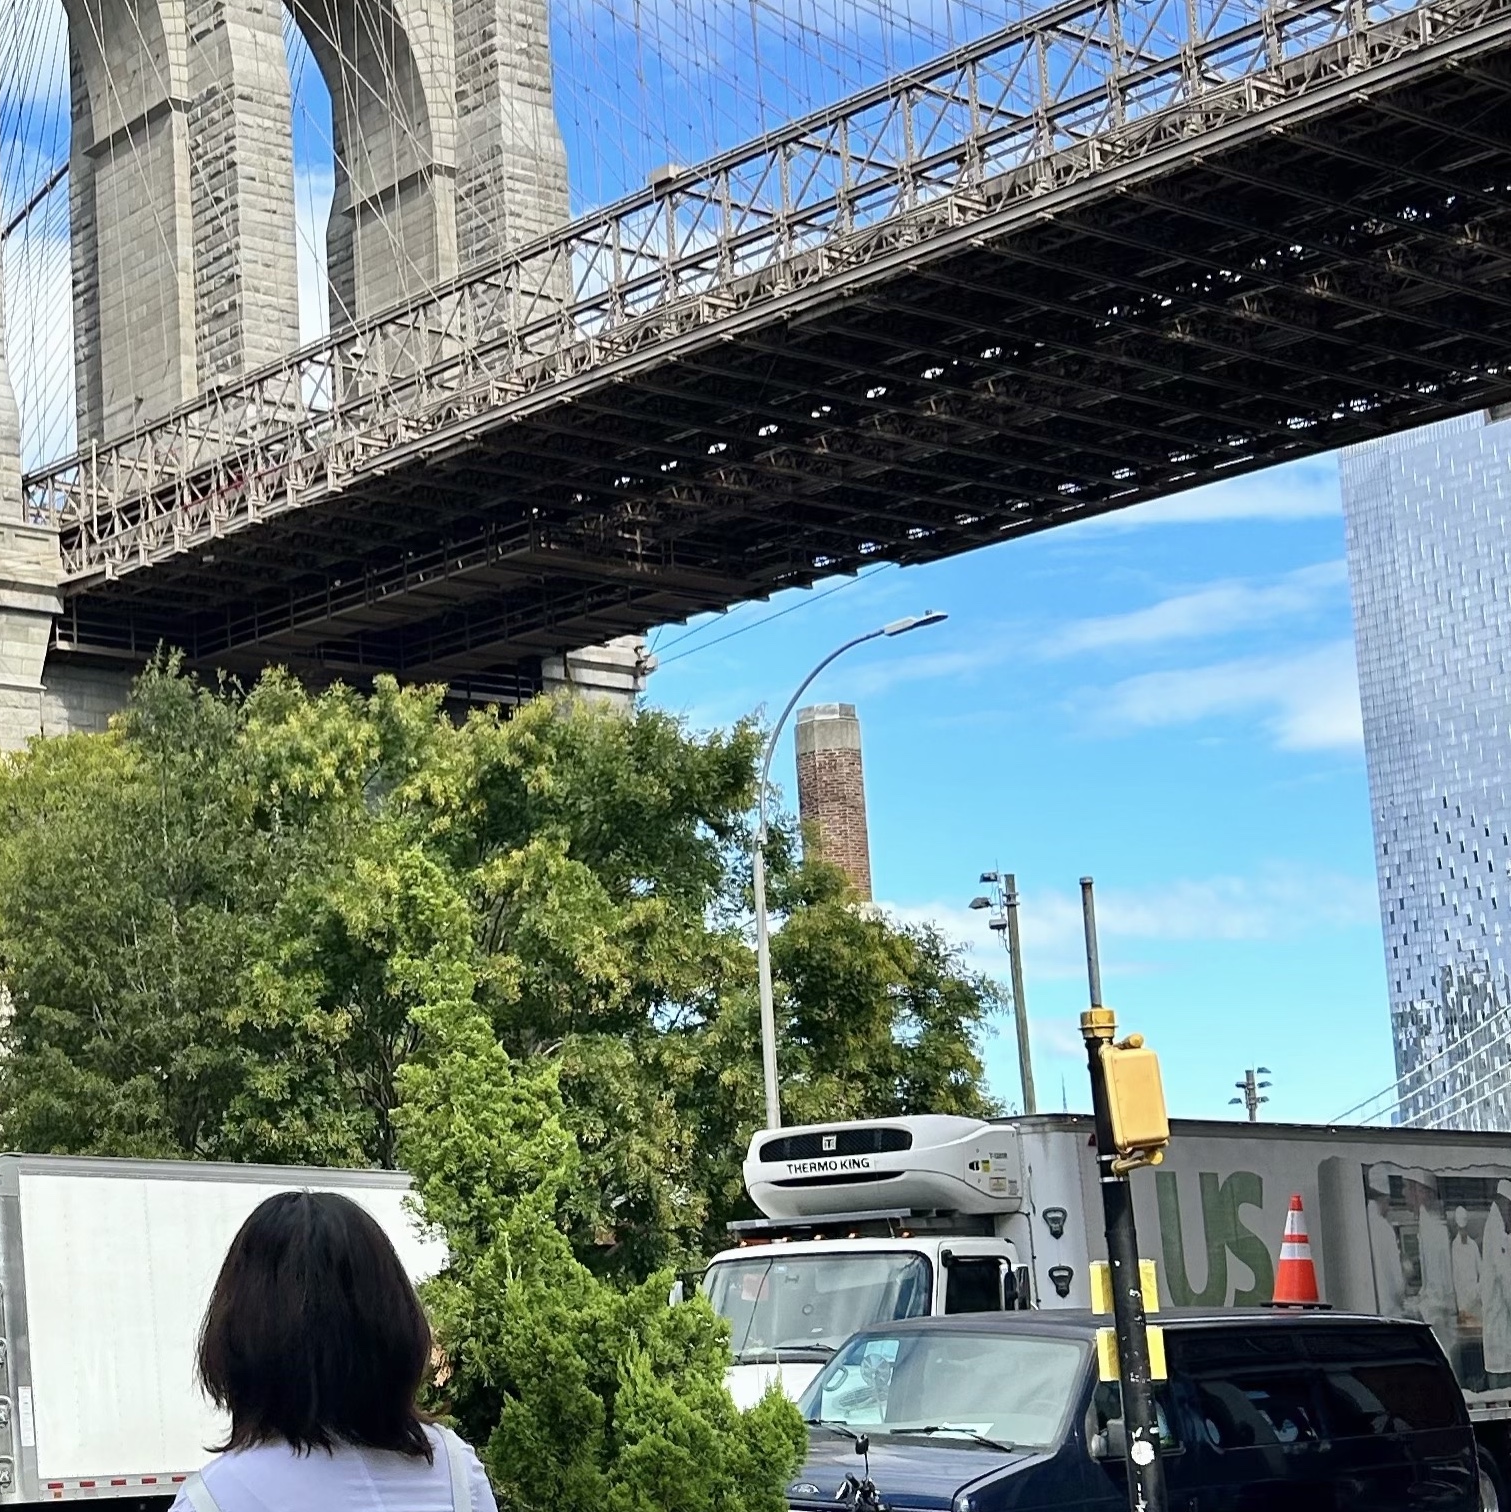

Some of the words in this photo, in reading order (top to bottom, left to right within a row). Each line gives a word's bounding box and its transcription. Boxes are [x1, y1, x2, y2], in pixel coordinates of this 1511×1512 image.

[787, 1160, 837, 1174] THERMO
[840, 1158, 870, 1170] KING
[1155, 1171, 1275, 1307] US
